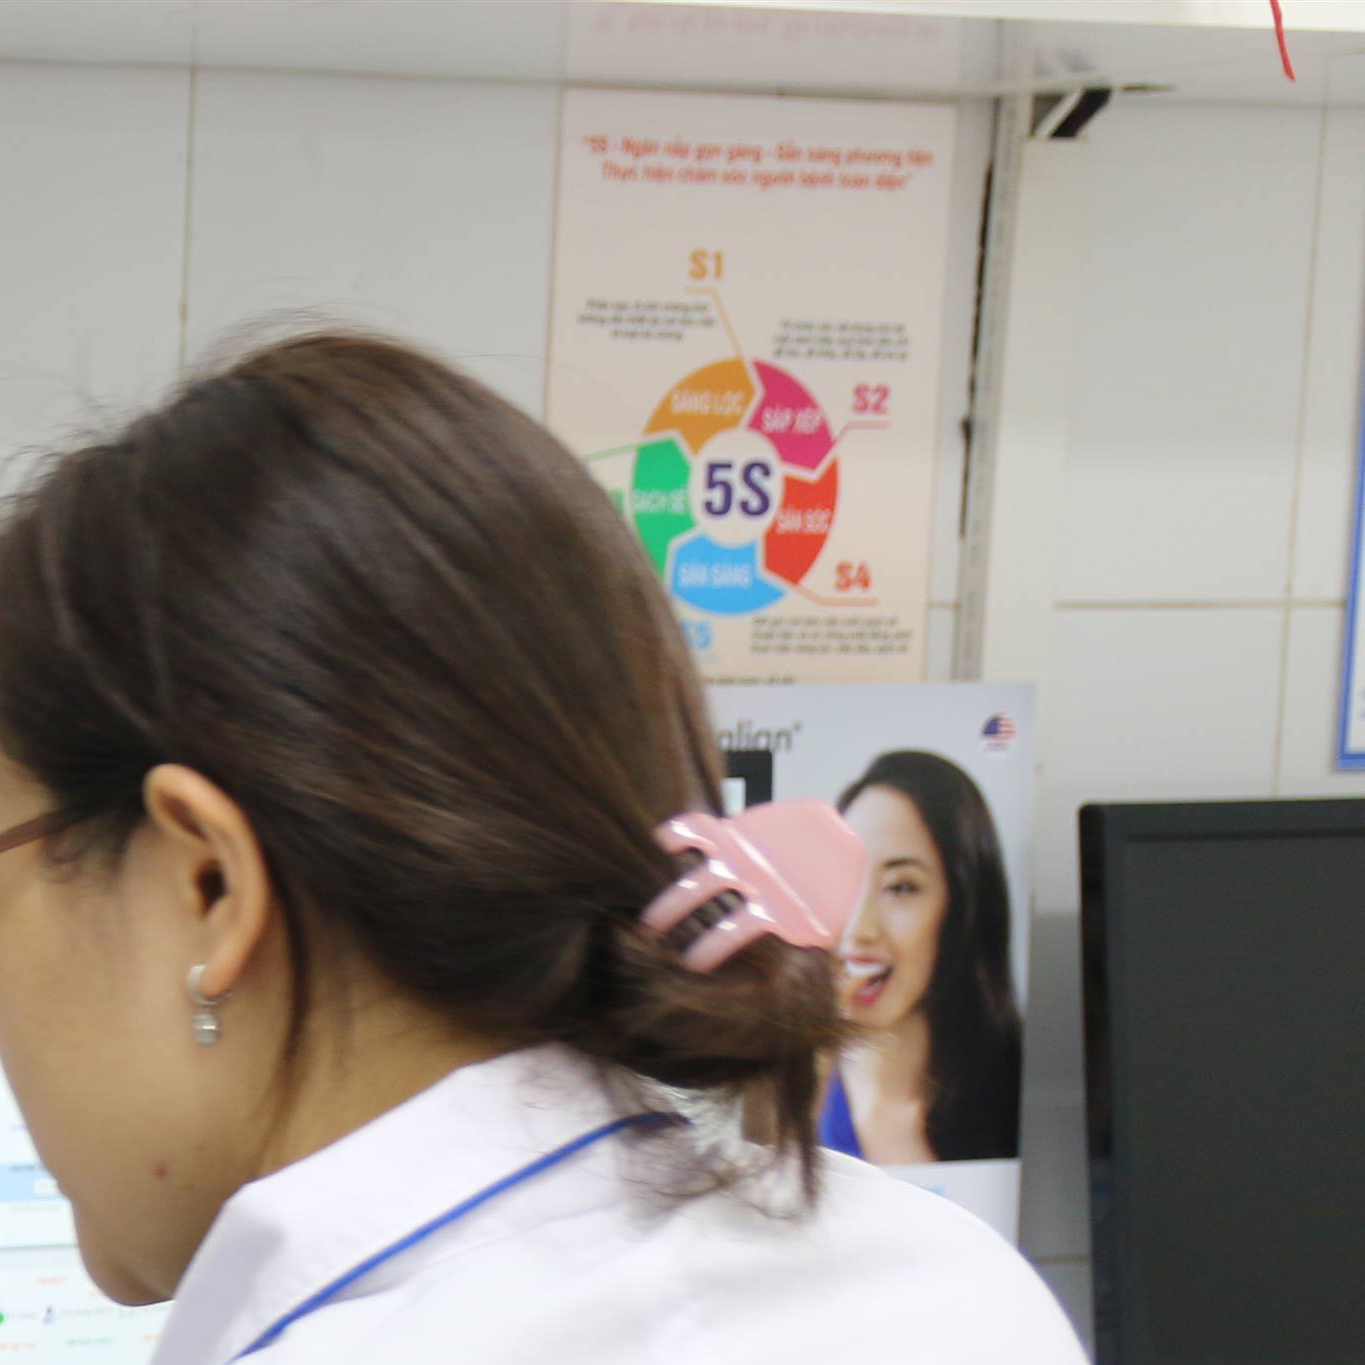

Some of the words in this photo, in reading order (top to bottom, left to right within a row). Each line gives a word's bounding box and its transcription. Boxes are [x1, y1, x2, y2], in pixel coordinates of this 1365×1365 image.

[689, 248, 724, 281] S1
[853, 384, 890, 415] S2
[704, 460, 772, 517] 5S
[834, 561, 871, 592] S4
